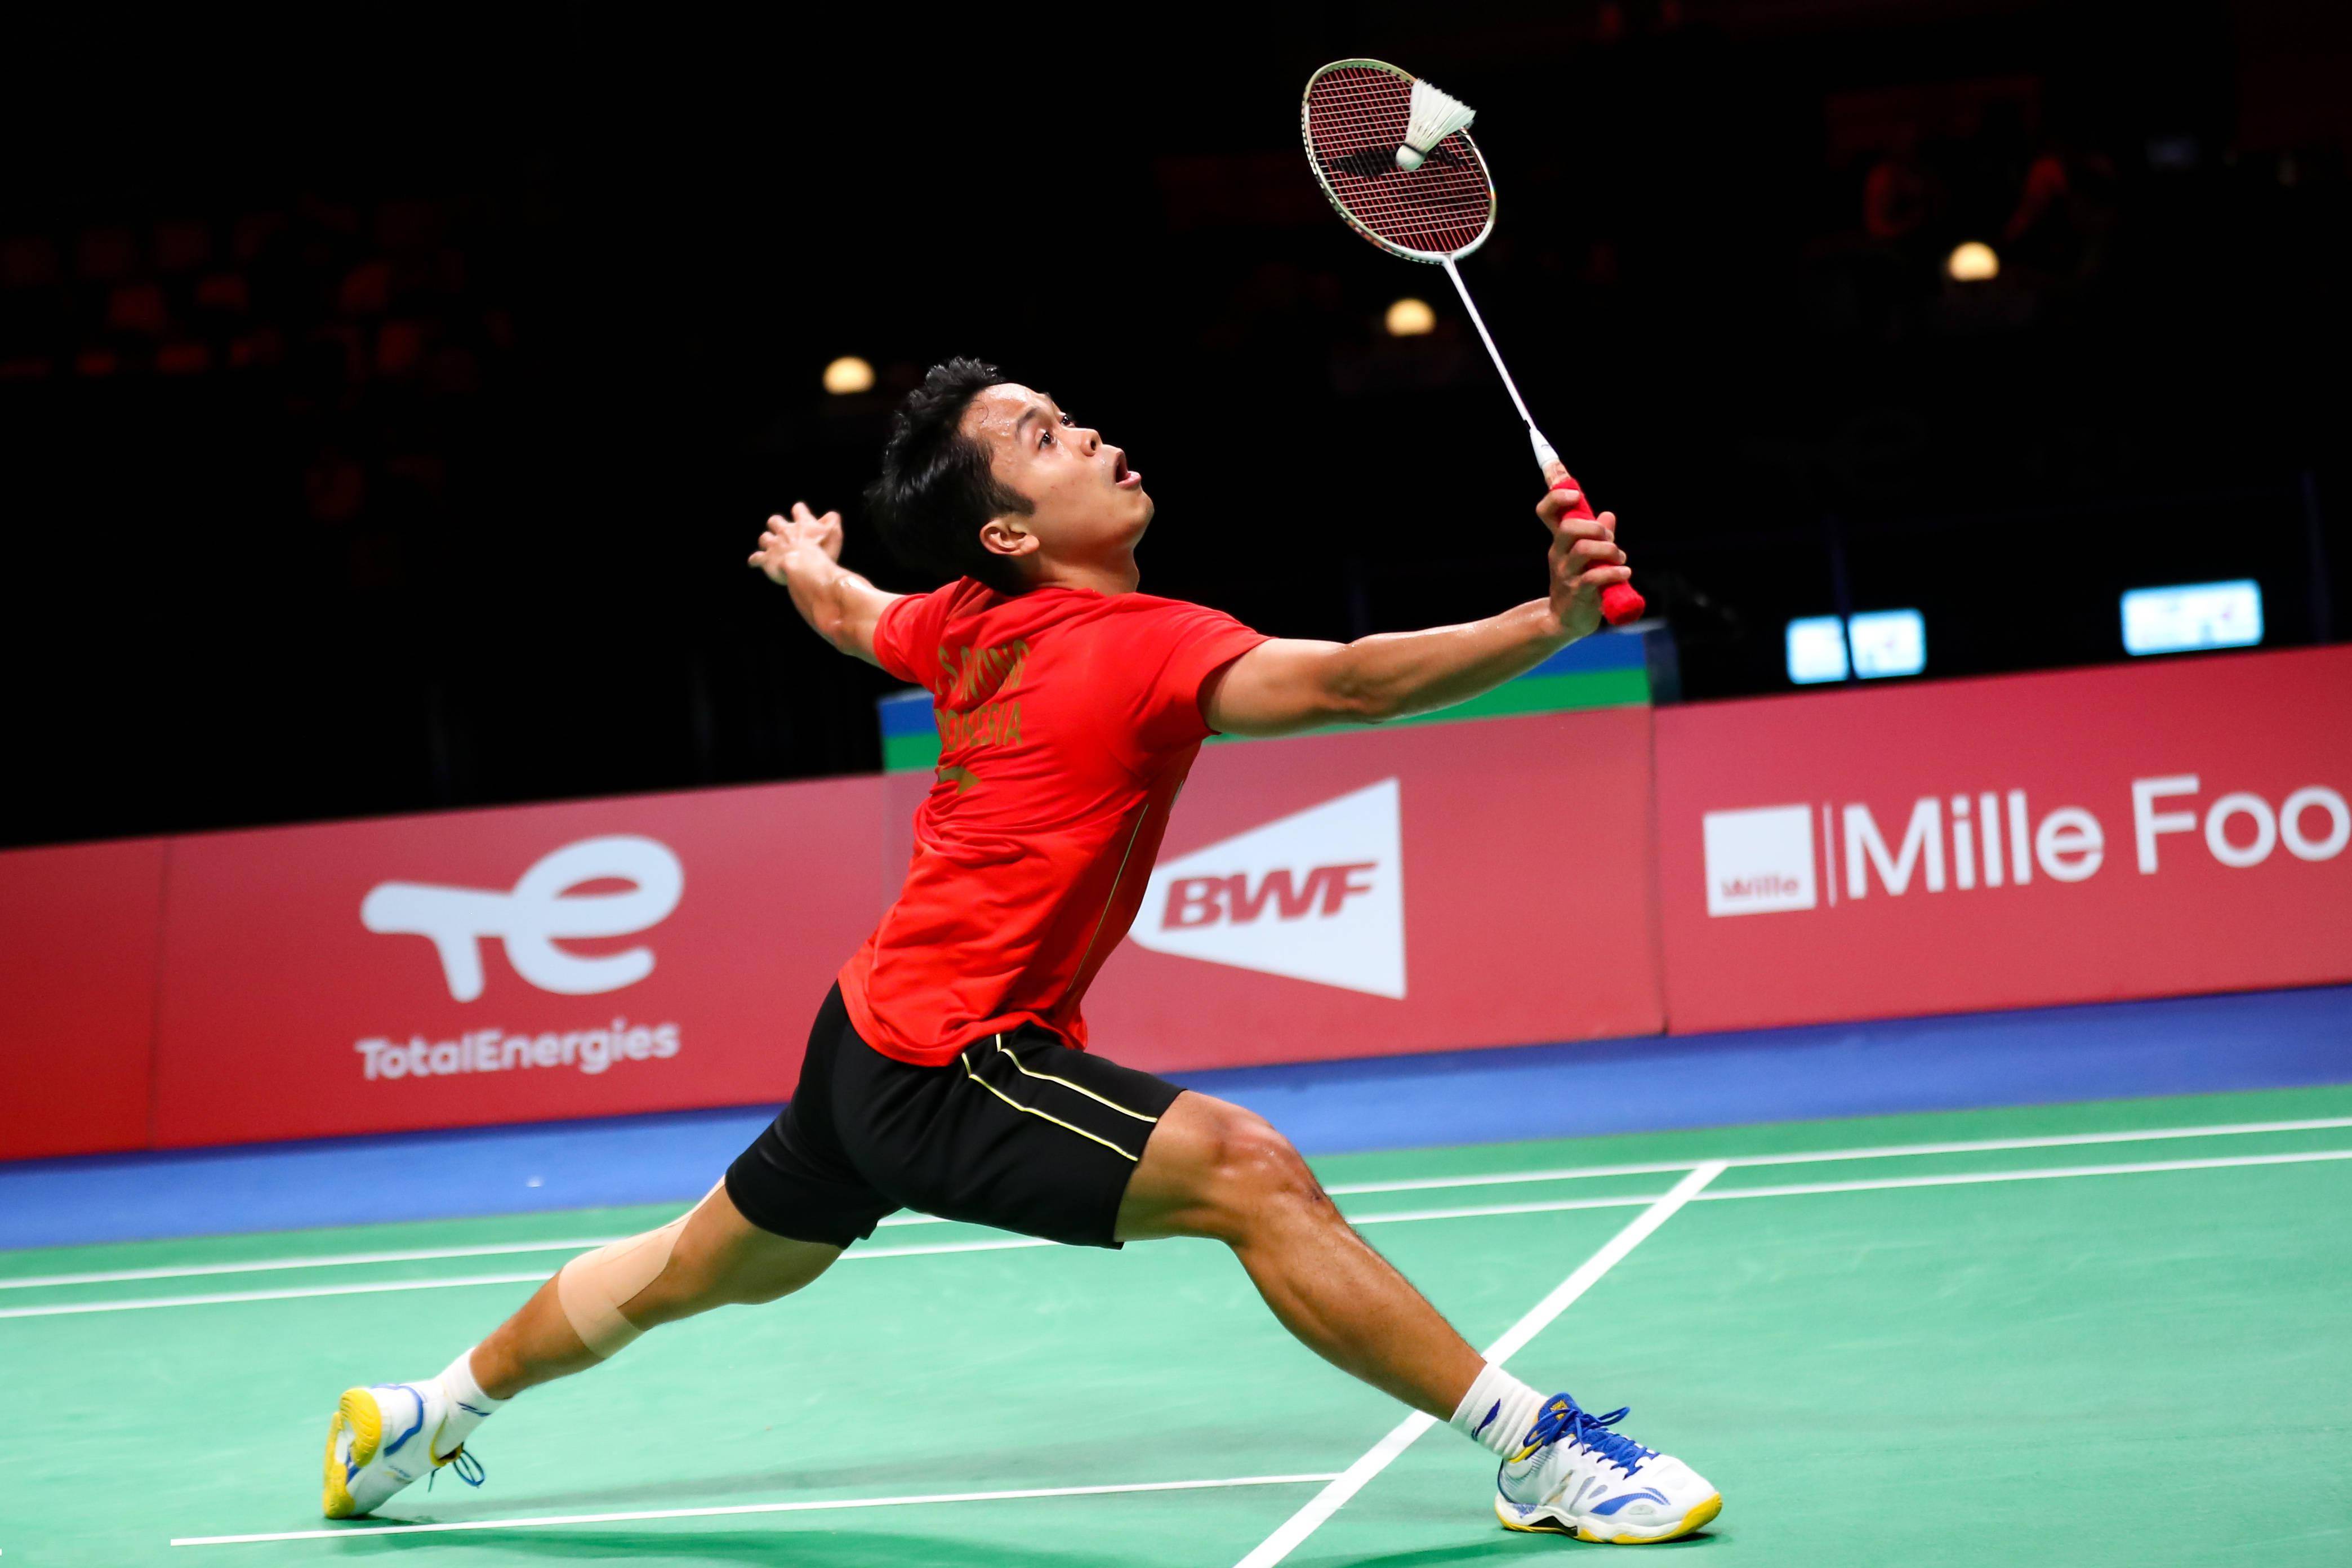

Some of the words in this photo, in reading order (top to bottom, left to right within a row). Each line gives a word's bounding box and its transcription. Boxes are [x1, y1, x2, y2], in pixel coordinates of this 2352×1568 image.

[1843, 789, 2104, 899] Mille
[2132, 768, 2351, 876] Foo
[1160, 862, 1378, 932] BWF
[355, 1017, 680, 1080] TotalEnergies
